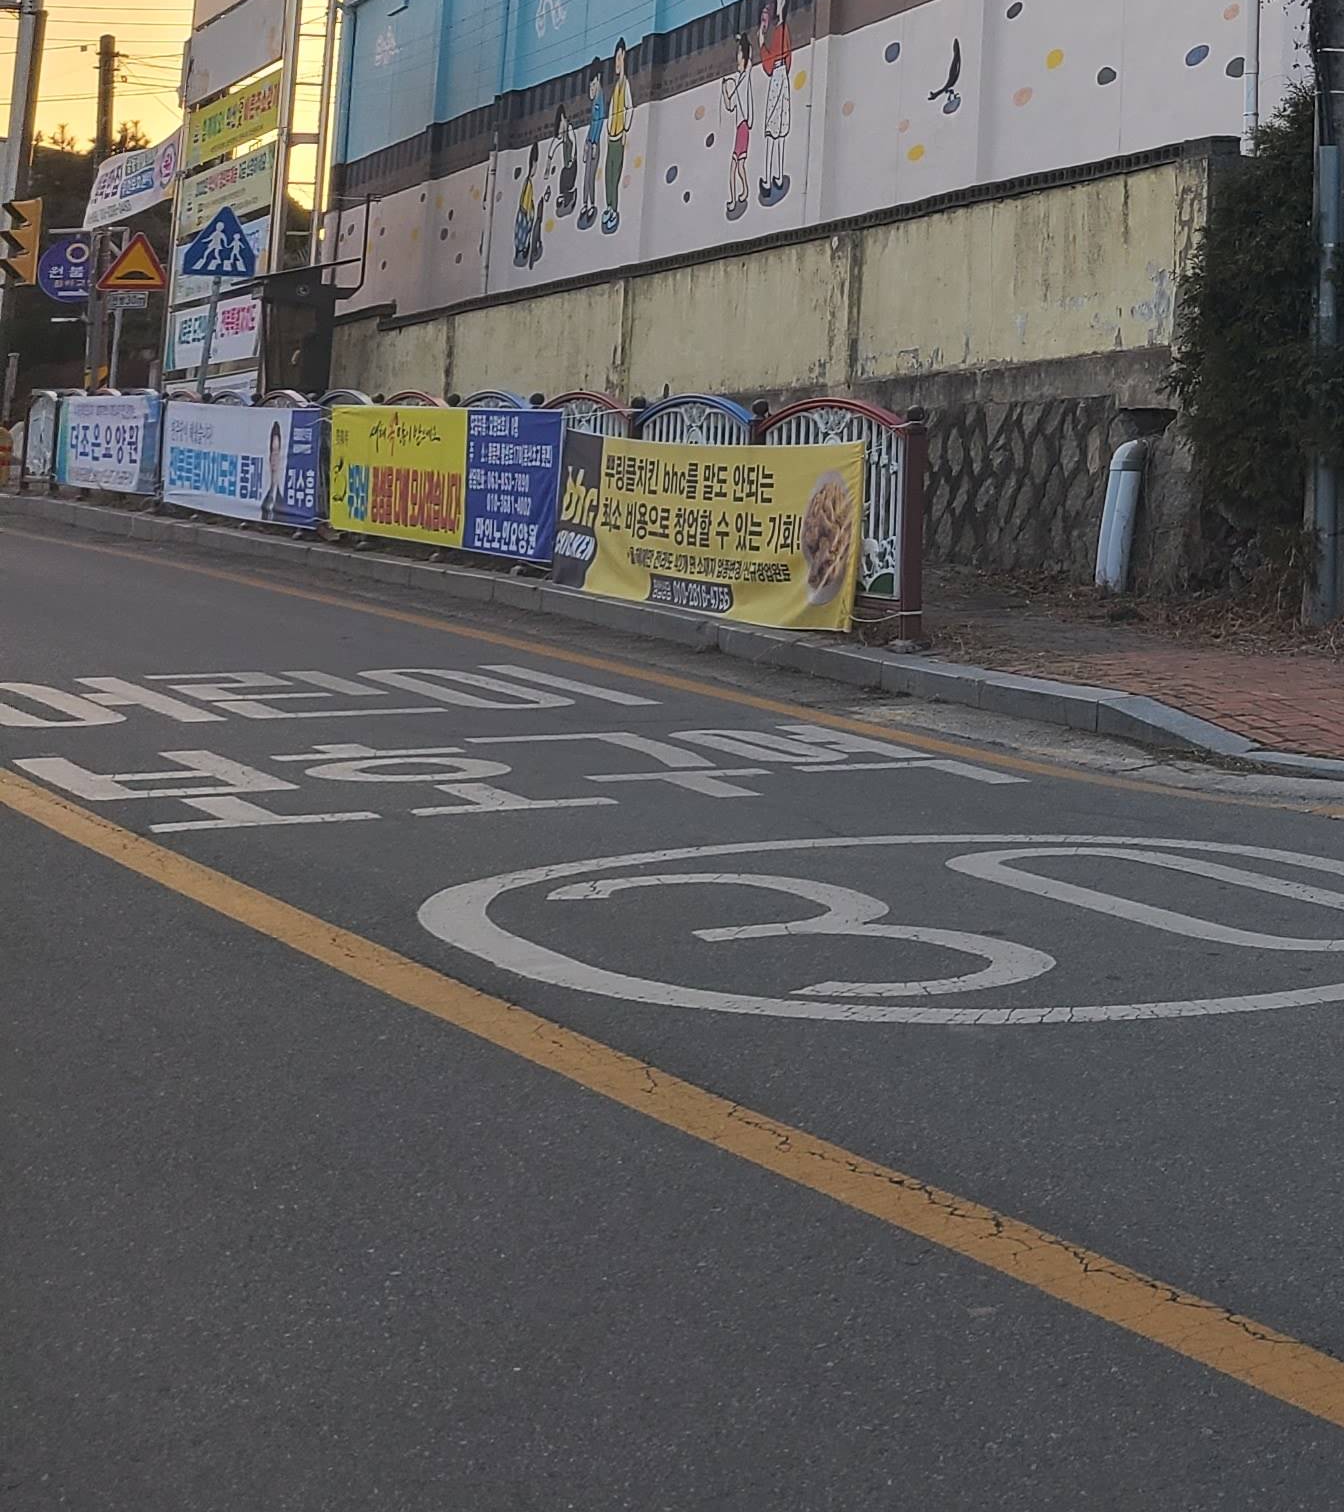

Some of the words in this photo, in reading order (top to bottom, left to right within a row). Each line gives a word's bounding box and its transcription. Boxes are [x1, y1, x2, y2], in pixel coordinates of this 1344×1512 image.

[604, 454, 660, 495] 뿌링클치킨
[663, 462, 699, 500] bhc를
[702, 464, 728, 501] 말도
[732, 464, 775, 504] 안되는
[600, 496, 622, 533] 최소
[624, 500, 671, 540] 비용으로
[674, 507, 713, 548] 창업할
[715, 511, 730, 550] 수
[735, 511, 763, 552] 있는
[766, 513, 803, 555] 기회!
[0, 664, 664, 728] 어린이
[12, 724, 1032, 834] 보호구역
